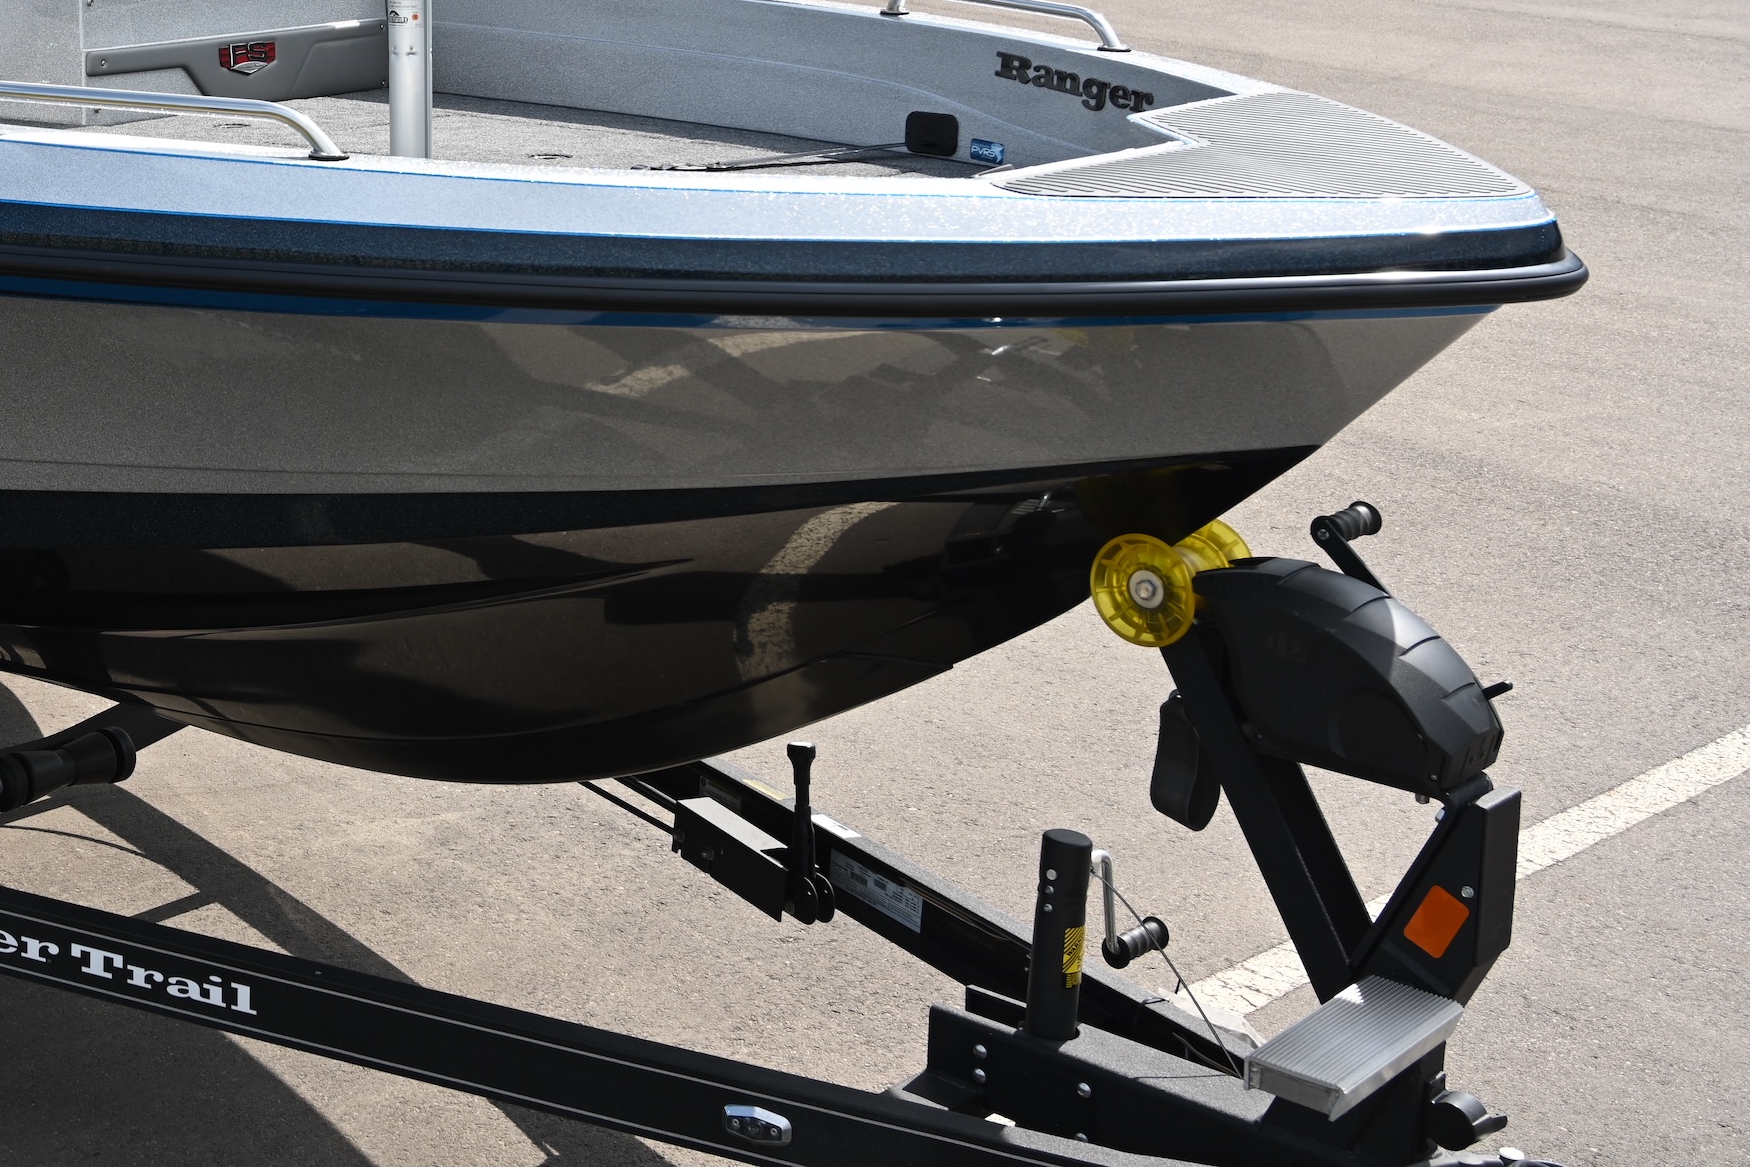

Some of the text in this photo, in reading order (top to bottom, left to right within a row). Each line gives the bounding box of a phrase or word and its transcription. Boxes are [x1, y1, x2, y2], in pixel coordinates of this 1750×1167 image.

[229, 41, 268, 66] FS
[994, 50, 1154, 112] Ranger
[971, 146, 996, 158] PVRS
[70, 943, 258, 1016] Trail
